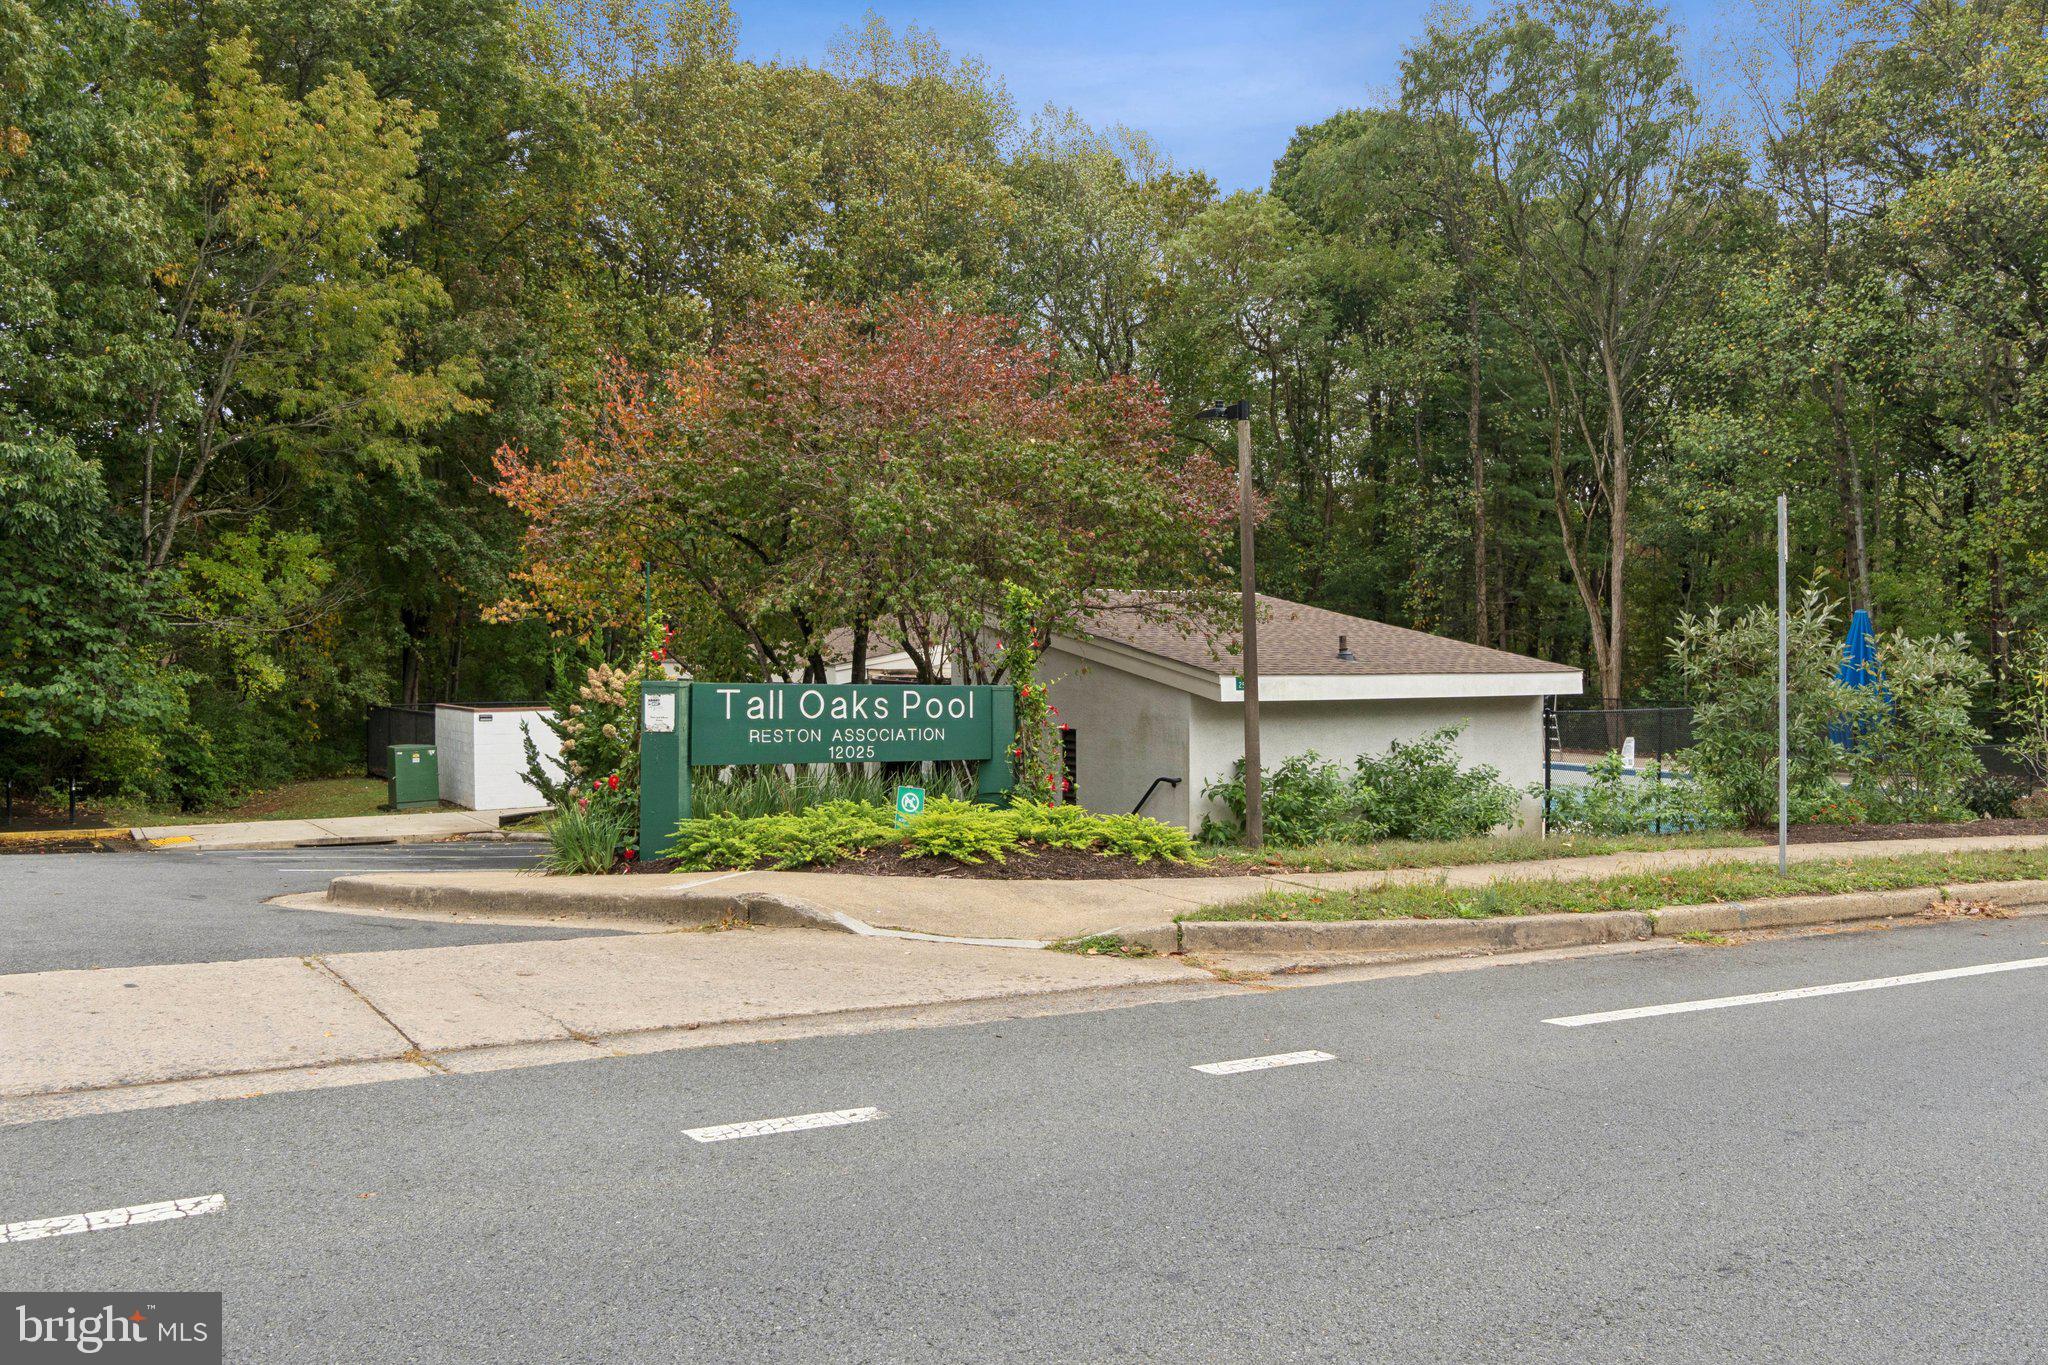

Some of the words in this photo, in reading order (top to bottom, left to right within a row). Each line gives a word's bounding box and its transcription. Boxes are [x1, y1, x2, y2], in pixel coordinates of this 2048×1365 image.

[716, 688, 784, 720] Tall
[799, 689, 889, 720] Oaks
[902, 690, 974, 719] Pool
[749, 728, 822, 743] RESTON
[832, 727, 945, 742] ASSOCIATION
[828, 745, 875, 759] 12025
